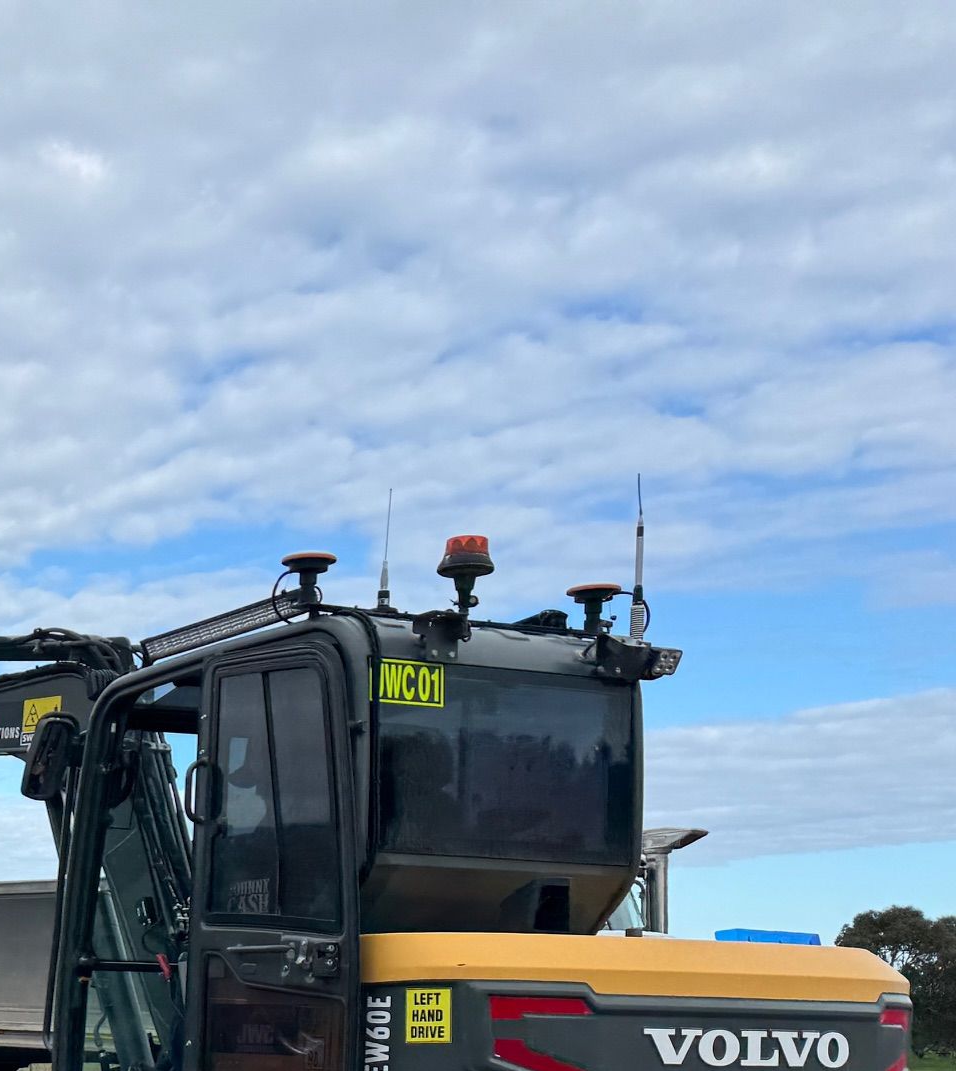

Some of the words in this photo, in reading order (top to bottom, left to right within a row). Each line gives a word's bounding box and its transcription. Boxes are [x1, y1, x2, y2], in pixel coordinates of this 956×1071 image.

[414, 993, 441, 1006] LEFT
[412, 1009, 443, 1022] HAND
[411, 1026, 445, 1038] DRIVE
[644, 1028, 850, 1068] VOLVO
